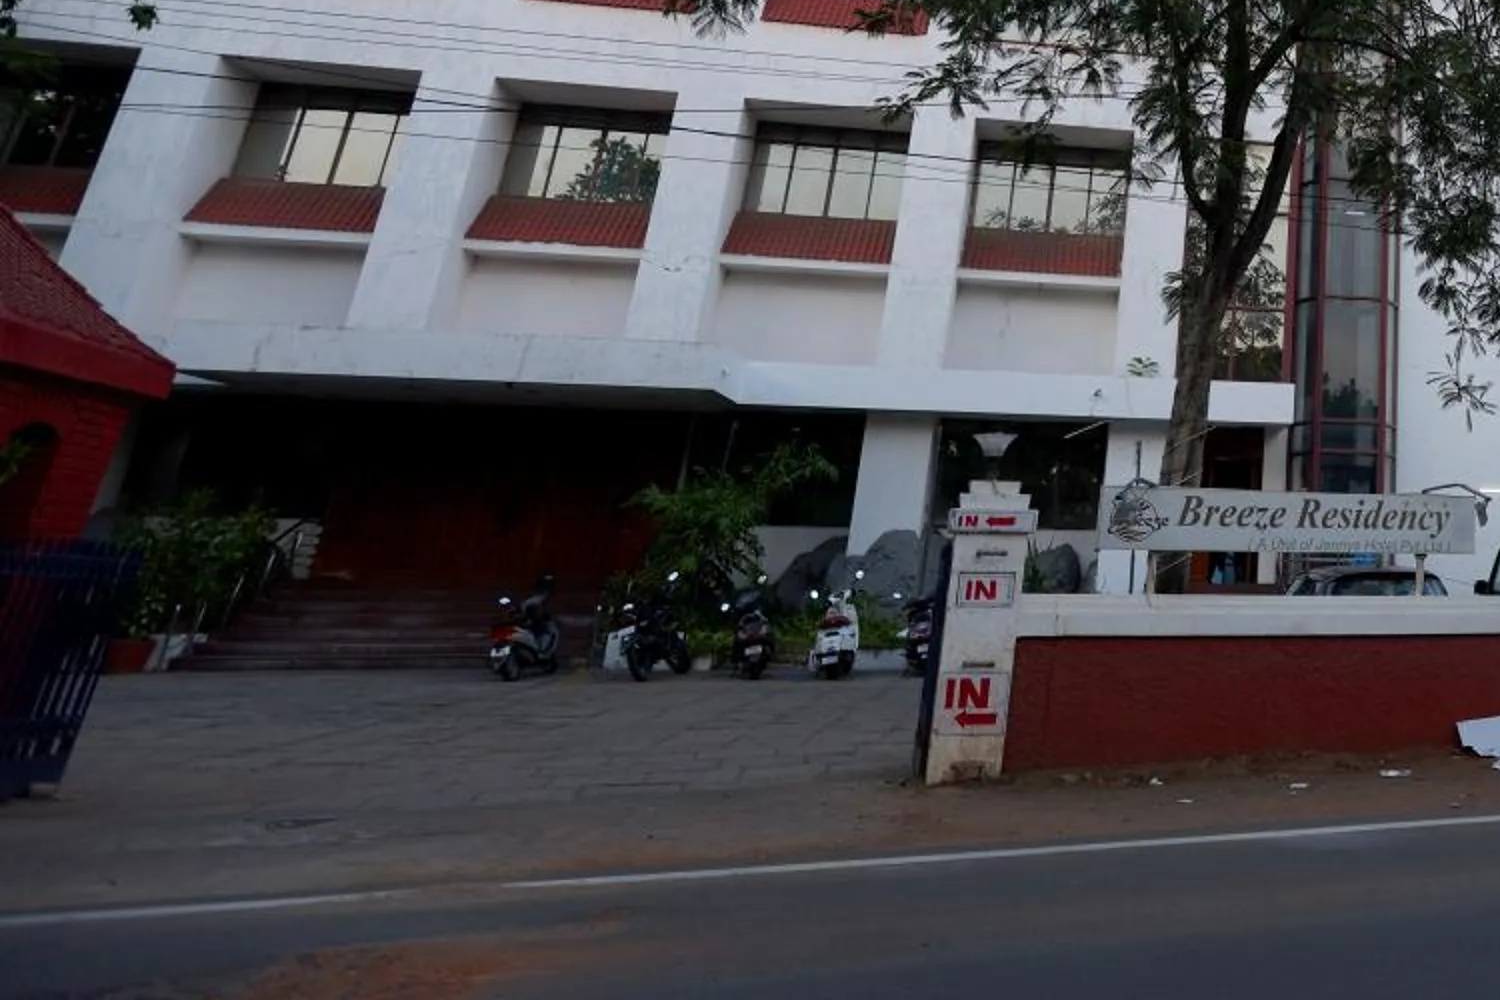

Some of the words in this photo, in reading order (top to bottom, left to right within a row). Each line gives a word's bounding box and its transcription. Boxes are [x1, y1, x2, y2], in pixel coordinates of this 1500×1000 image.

[958, 515, 979, 527] IN
[1177, 495, 1287, 531] Breeze
[1295, 497, 1451, 539] Residency
[965, 579, 997, 601] IN
[944, 677, 992, 710] IN
